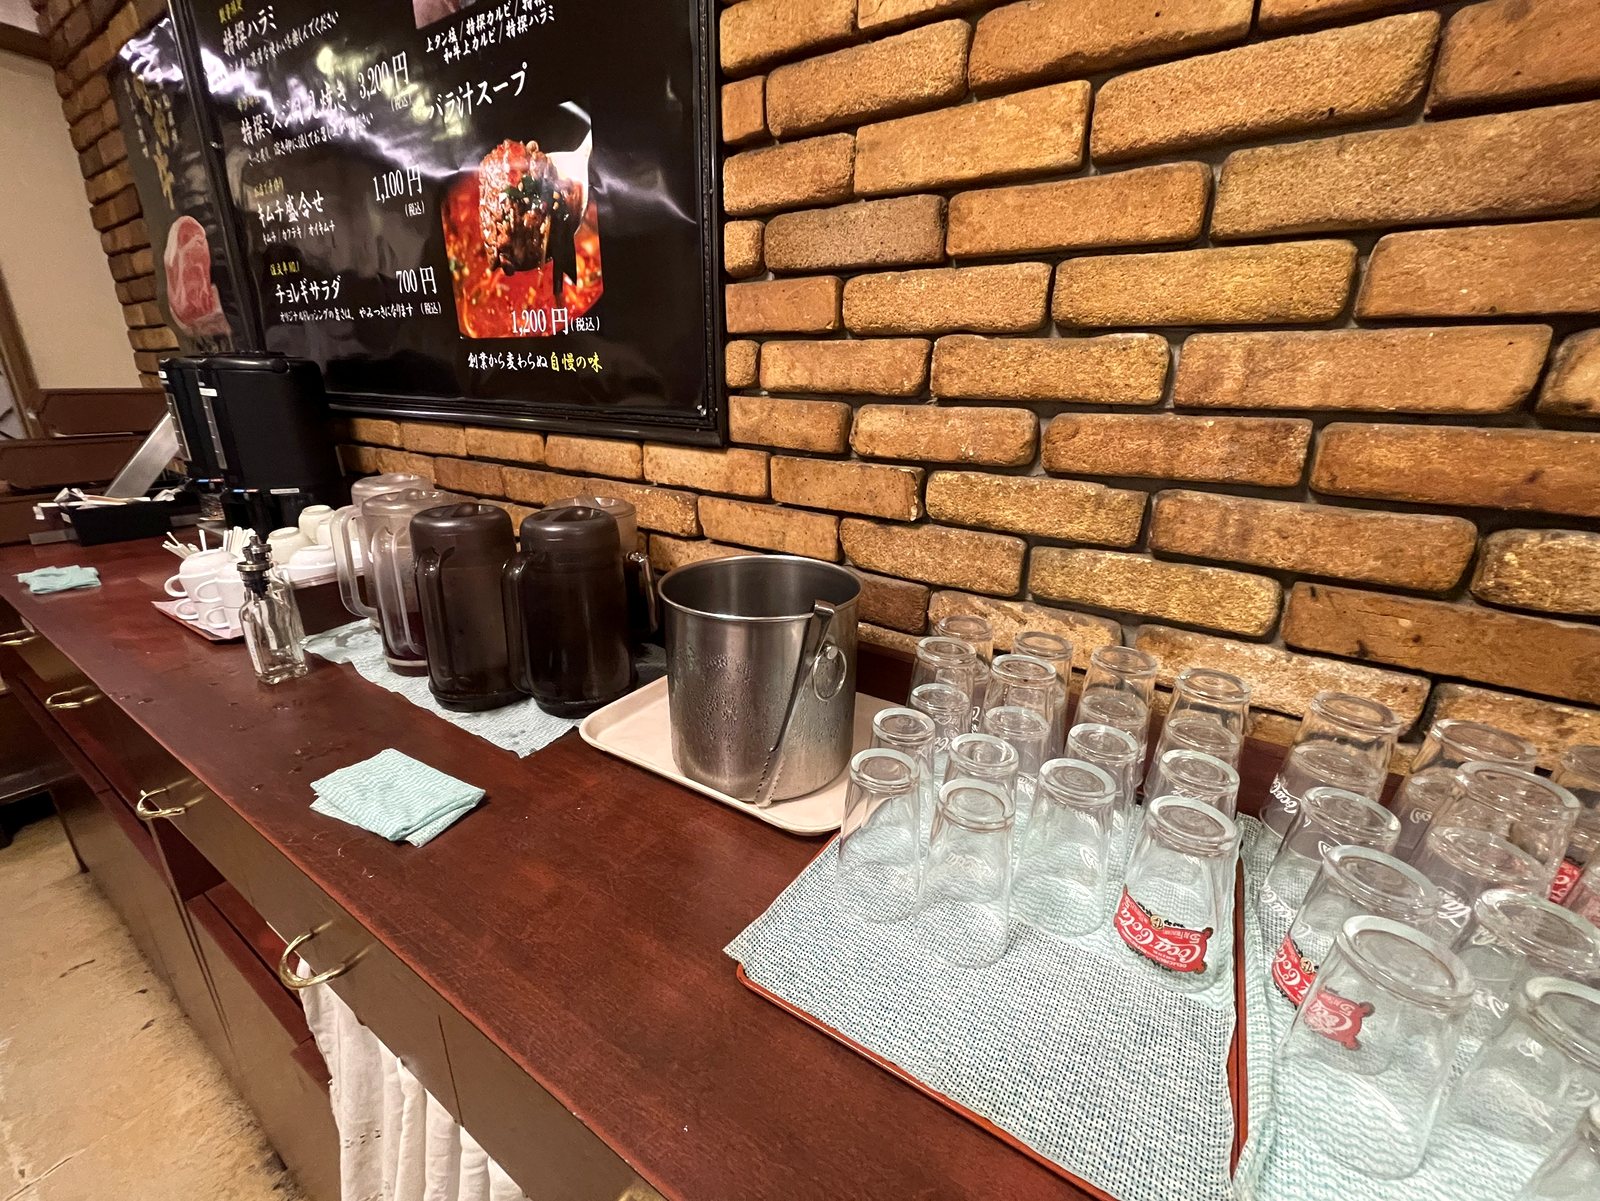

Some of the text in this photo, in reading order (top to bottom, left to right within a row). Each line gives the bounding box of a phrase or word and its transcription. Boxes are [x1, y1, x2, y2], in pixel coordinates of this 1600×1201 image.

[428, 61, 528, 119] バラ汁スープ
[275, 275, 342, 304] チョレギサラダ
